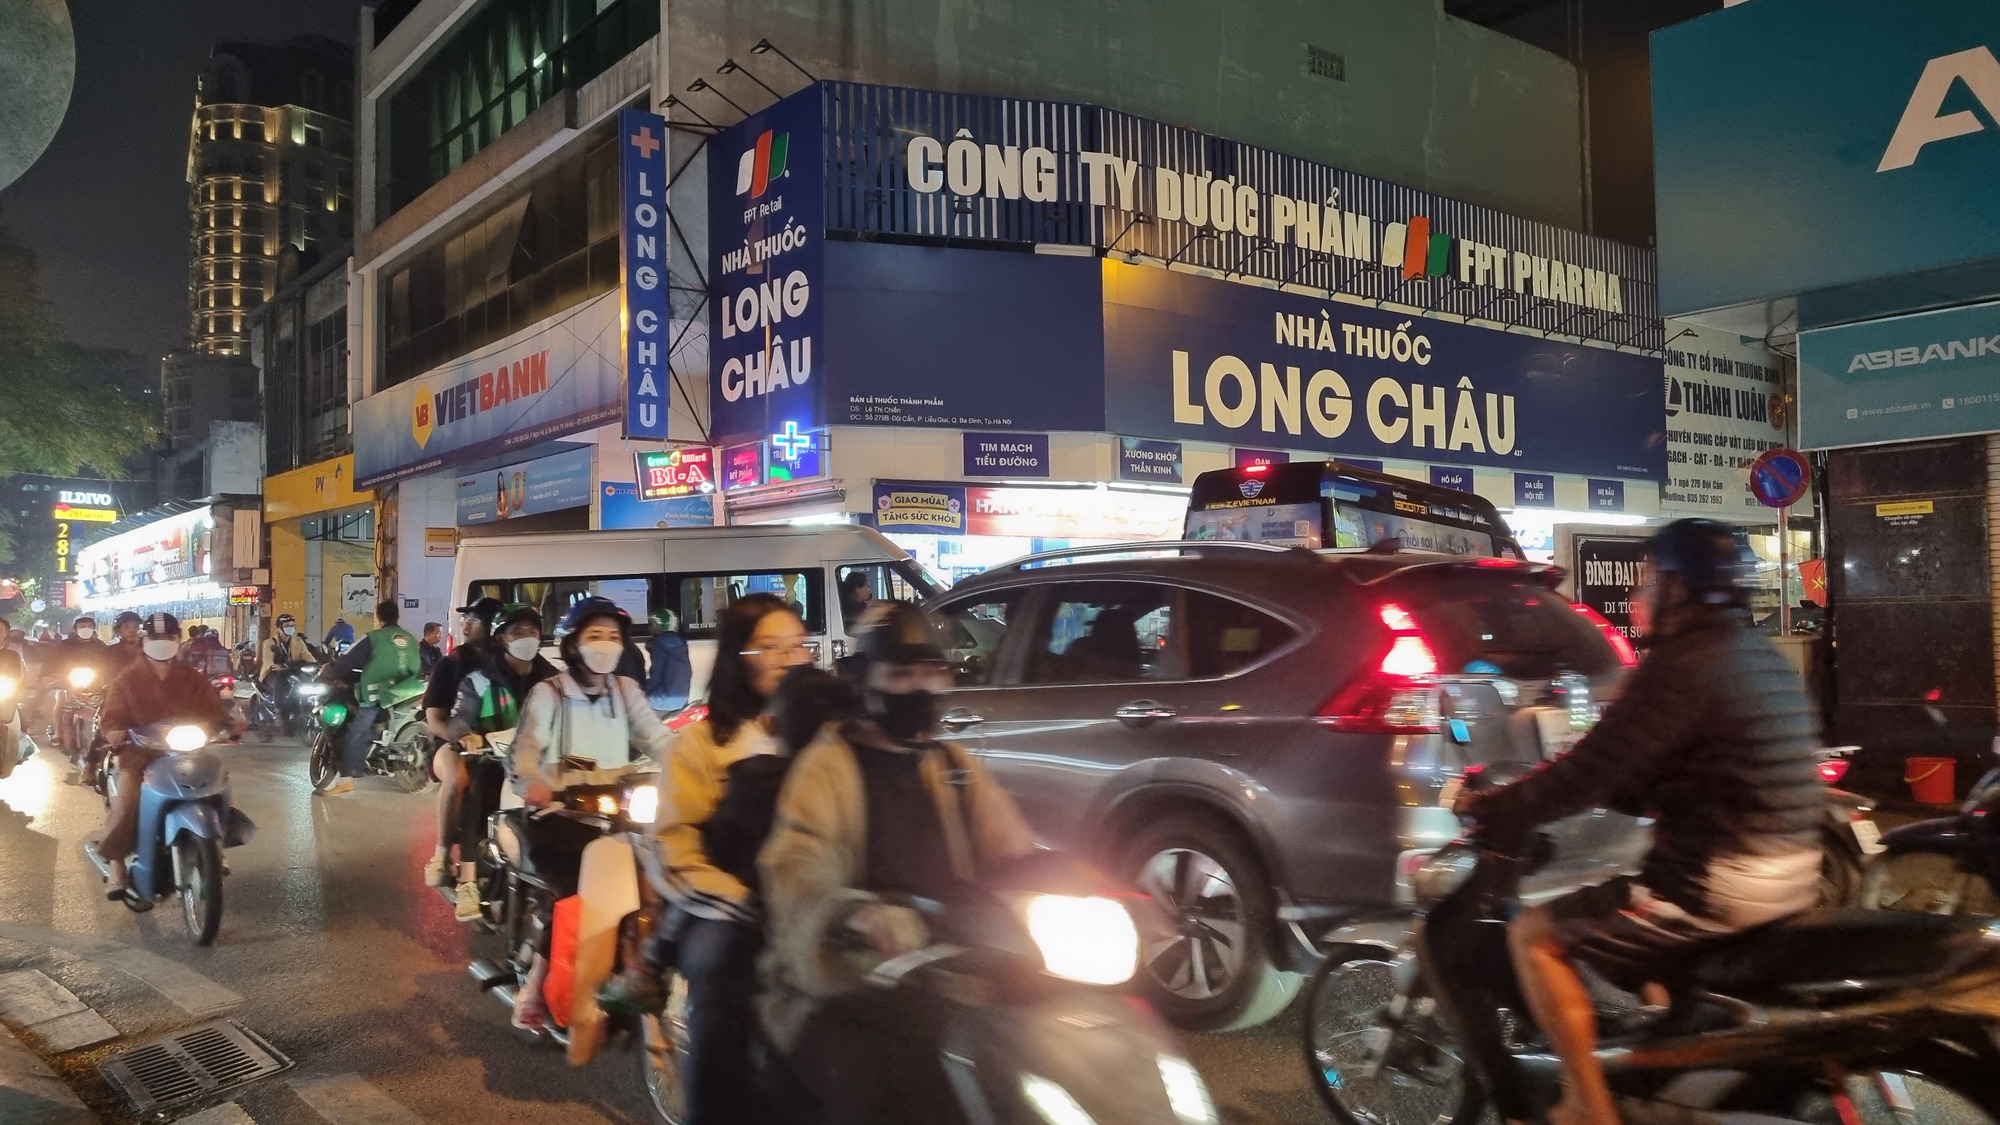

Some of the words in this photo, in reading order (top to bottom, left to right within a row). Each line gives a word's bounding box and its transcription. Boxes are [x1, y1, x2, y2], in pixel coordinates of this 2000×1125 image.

[744, 209, 756, 224] FPT
[907, 128, 1057, 202] CÔNG
[1080, 151, 1138, 211] TY
[1155, 167, 1258, 237] DƯỢC
[1273, 187, 1371, 262] PHẨM
[1459, 238, 1508, 290] FPT
[1514, 251, 1623, 314] PHARMA
[634, 171, 658, 290] LONG
[722, 239, 751, 275] NHÀ
[754, 216, 806, 263] THUỐC
[721, 270, 809, 339] LONG
[1275, 308, 1336, 352] NHÀ
[1342, 319, 1432, 366] THUỐC
[1663, 347, 1685, 367] CÔNG
[1687, 352, 1697, 369] TY
[1713, 354, 1733, 376] PHẦN
[1847, 335, 2000, 373] ABBANK
[635, 309, 658, 427] CHÂU
[721, 335, 811, 402] CHÂU
[434, 349, 549, 427] VIETBANK
[850, 395, 864, 403] BÁN
[875, 395, 898, 404] THUỐC
[900, 396, 922, 405] THÀNH
[924, 396, 943, 406] PHẨM
[1172, 350, 1352, 439] LONG
[1366, 376, 1515, 455] CHÂU
[1683, 380, 1732, 418] THÀNH
[1735, 387, 1766, 423] LUÂN
[1862, 402, 1931, 416] www.abbank.vn
[1693, 432, 1713, 446] CUNG
[1714, 432, 1728, 448] CẤP
[980, 443, 997, 451] TIM
[1000, 444, 1033, 454] MẠCH
[1125, 449, 1153, 460] XƯƠNG
[1155, 450, 1177, 462] KHỚP
[647, 456, 669, 467] Green
[682, 453, 706, 463] Billiard
[789, 462, 793, 470] Y
[794, 457, 801, 469] TẾ
[975, 453, 996, 466] TIỂU
[999, 456, 1038, 467] ĐƯỜNG
[1130, 461, 1151, 473] THẦN
[1153, 465, 1172, 475] KINH
[650, 465, 705, 486] BI-A
[1450, 475, 1463, 484] HẤP
[1691, 478, 1700, 488] 279
[1525, 481, 1533, 489] DA
[894, 496, 918, 504] GIAO
[920, 495, 945, 506] MÙA!
[1524, 491, 1534, 500] NỘI
[883, 511, 909, 521] TĂNG
[911, 511, 929, 521] SỨC
[931, 512, 957, 523] KHỎE
[57, 522, 69, 573] 281
[1585, 553, 1613, 586] ĐÌNH
[1615, 561, 1635, 592] ĐẠI
[1604, 601, 1616, 614] DI
[1618, 598, 1640, 614] TÍC
